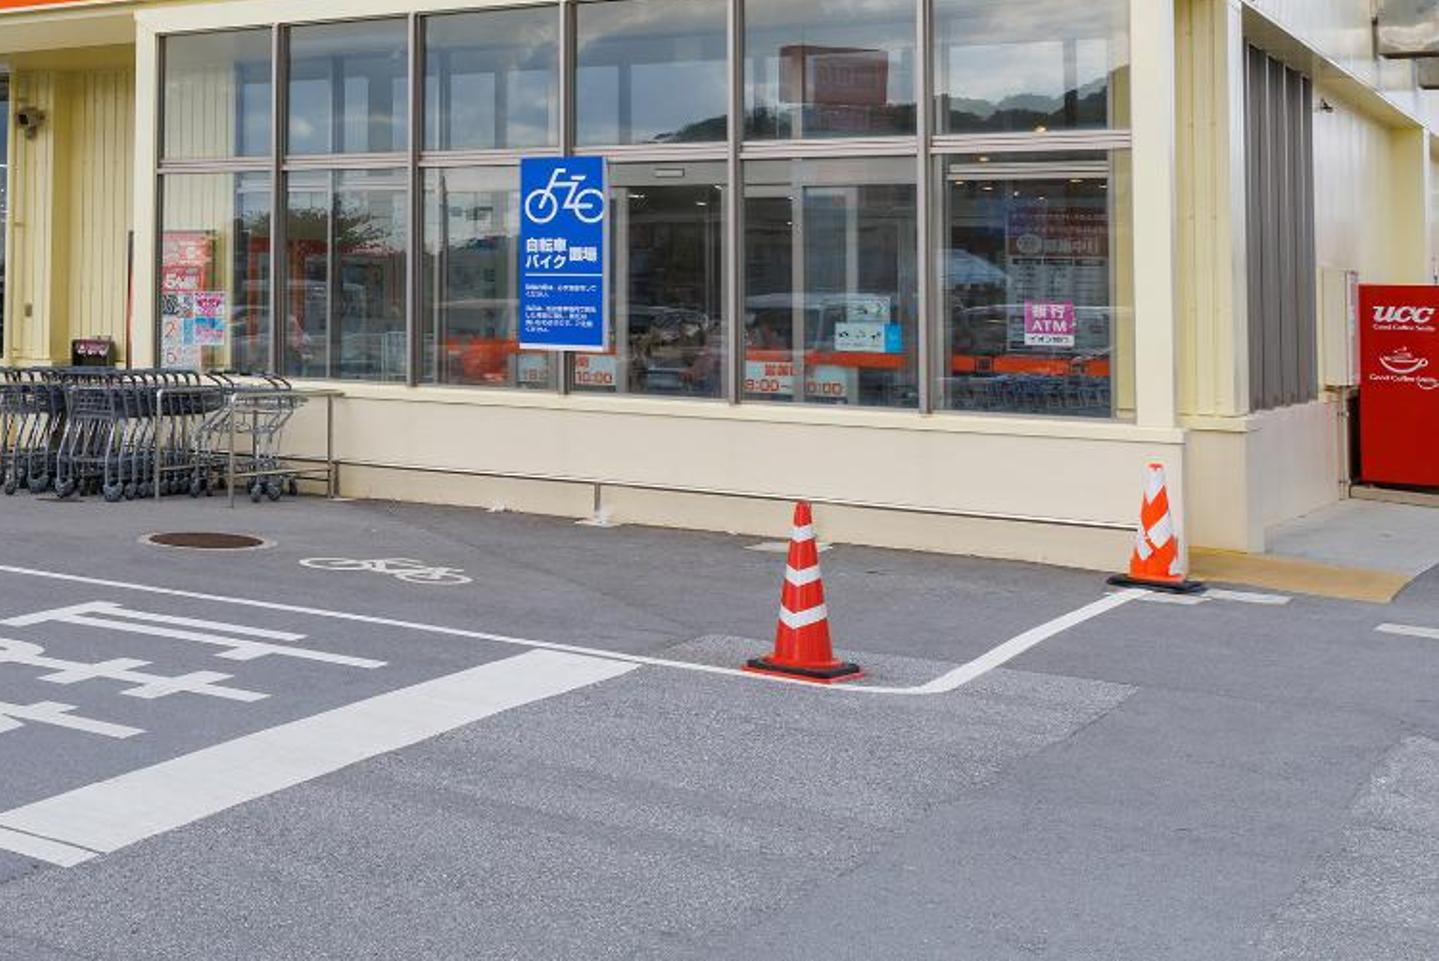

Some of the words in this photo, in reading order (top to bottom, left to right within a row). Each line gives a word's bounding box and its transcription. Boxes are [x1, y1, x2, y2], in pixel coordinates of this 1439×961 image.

[526, 237, 567, 253] 自転車
[525, 254, 567, 269] バイク
[1031, 319, 1068, 332] ATM
